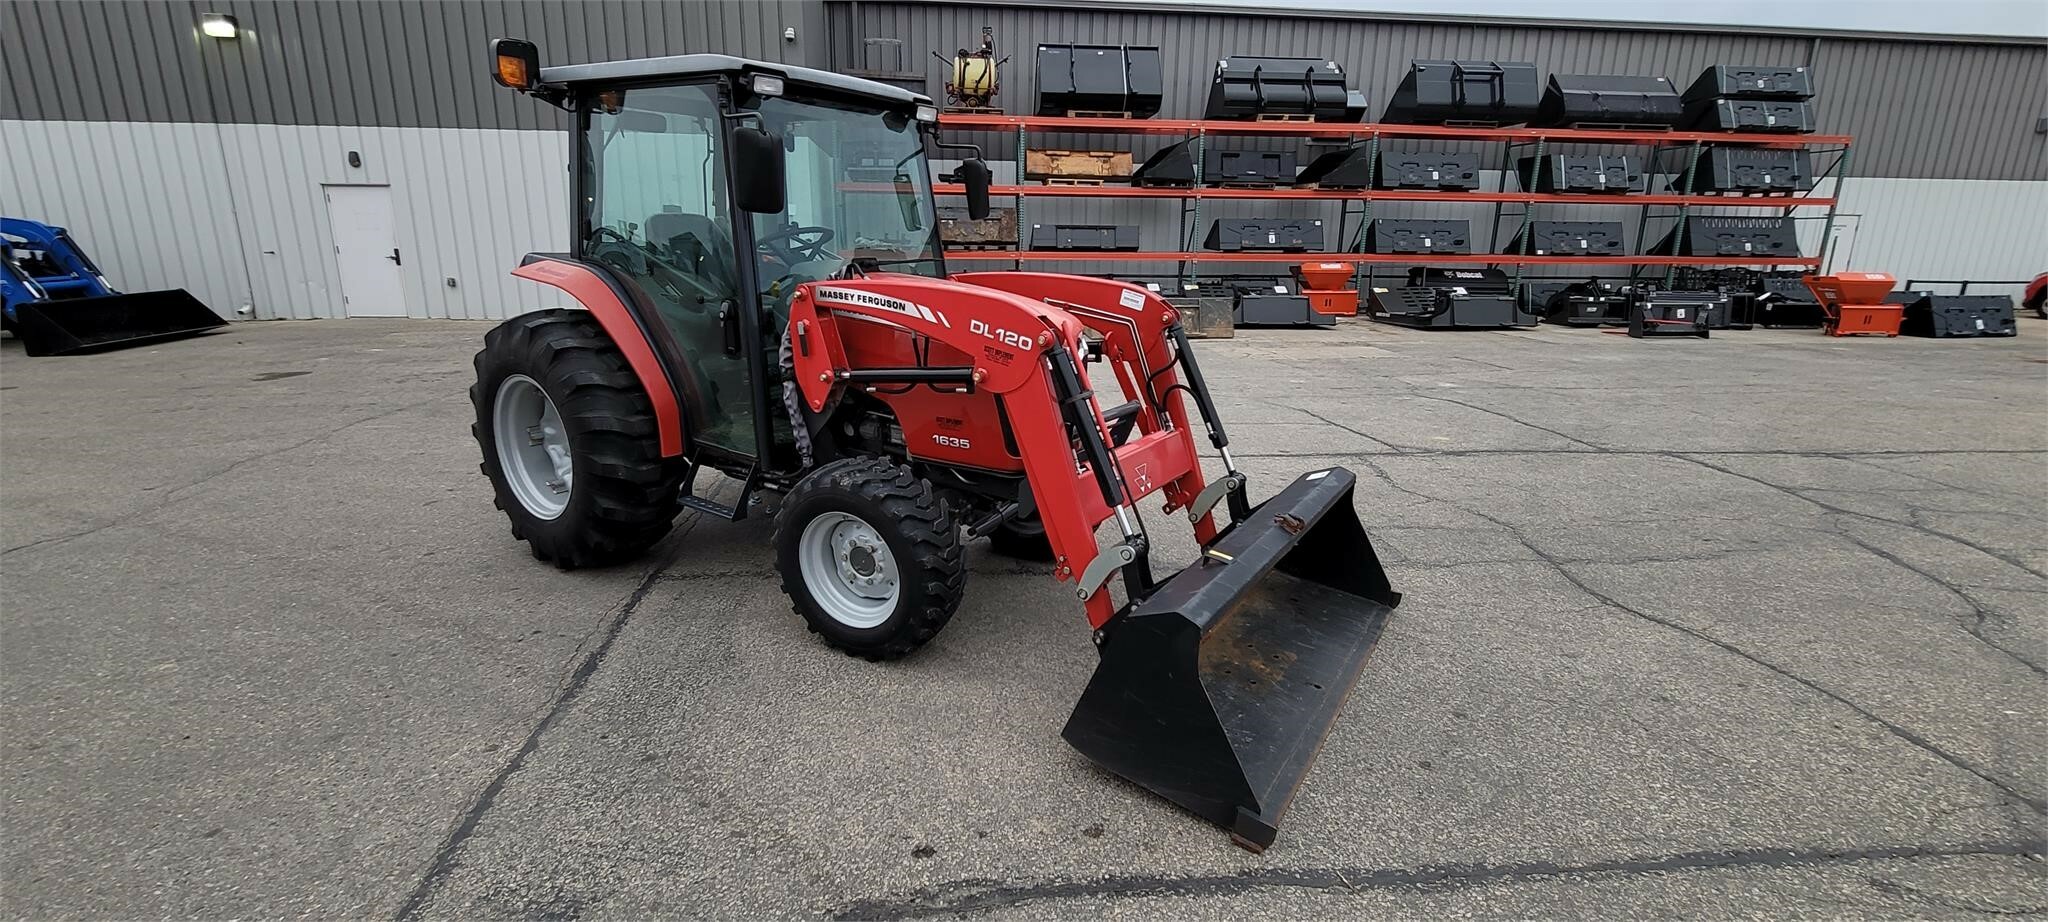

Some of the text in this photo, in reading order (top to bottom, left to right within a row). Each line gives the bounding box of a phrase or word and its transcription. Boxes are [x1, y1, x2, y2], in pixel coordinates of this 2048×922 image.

[819, 290, 906, 311] MASSEY FERGUSON
[969, 319, 1033, 351] DL120
[932, 434, 970, 449] 1635
